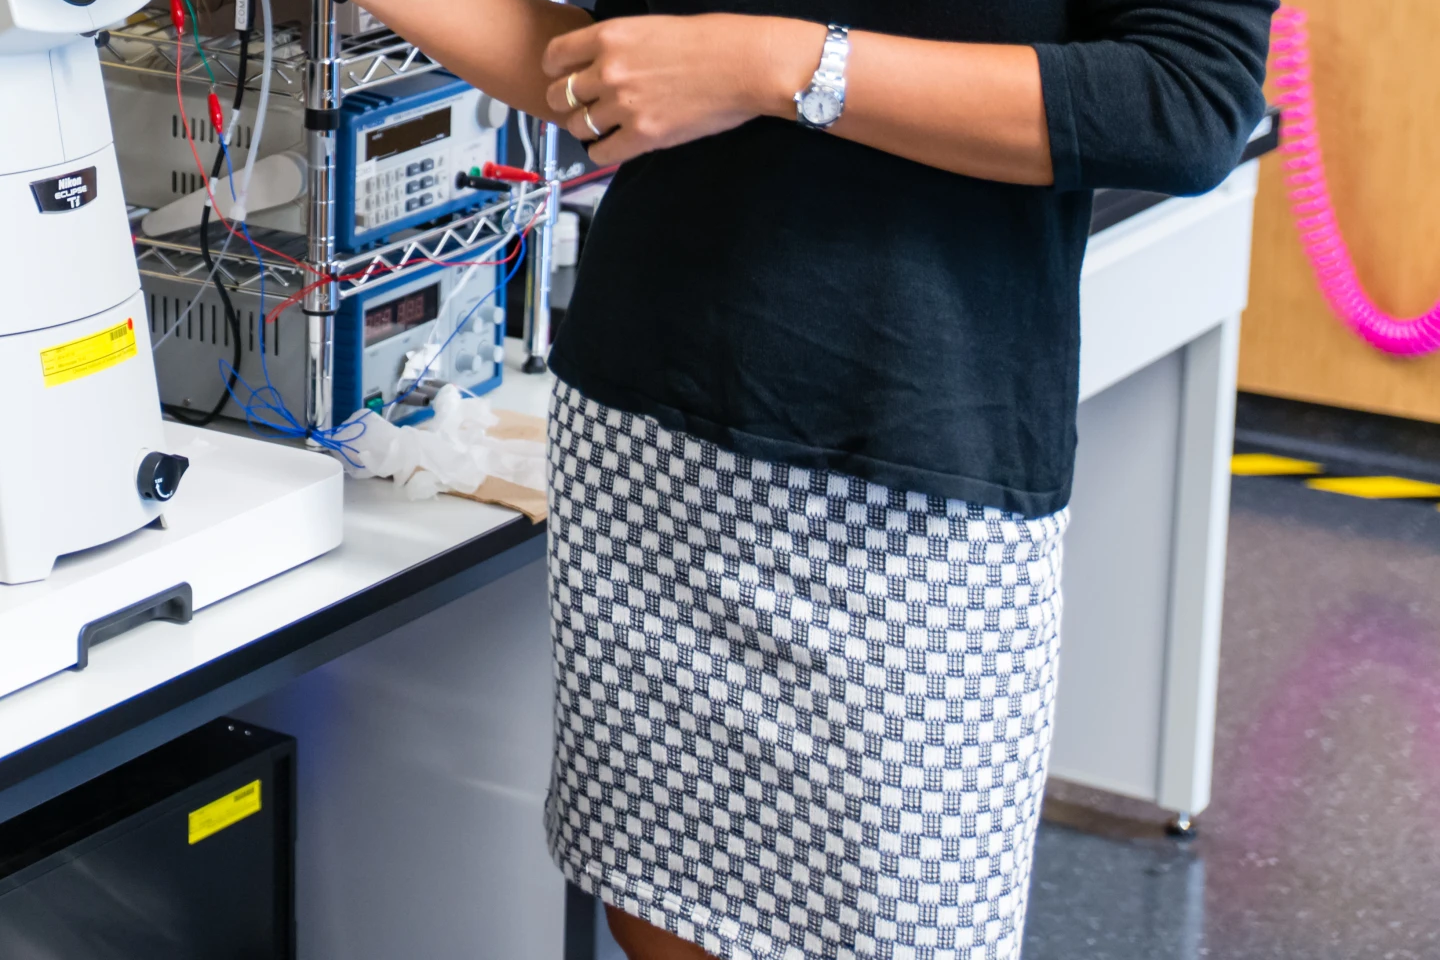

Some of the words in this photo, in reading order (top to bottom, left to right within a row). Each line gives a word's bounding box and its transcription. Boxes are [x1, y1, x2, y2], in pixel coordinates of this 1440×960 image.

[58, 176, 82, 191] Nikon
[54, 185, 88, 200] ECLIPSE
[66, 195, 80, 209] Ti
